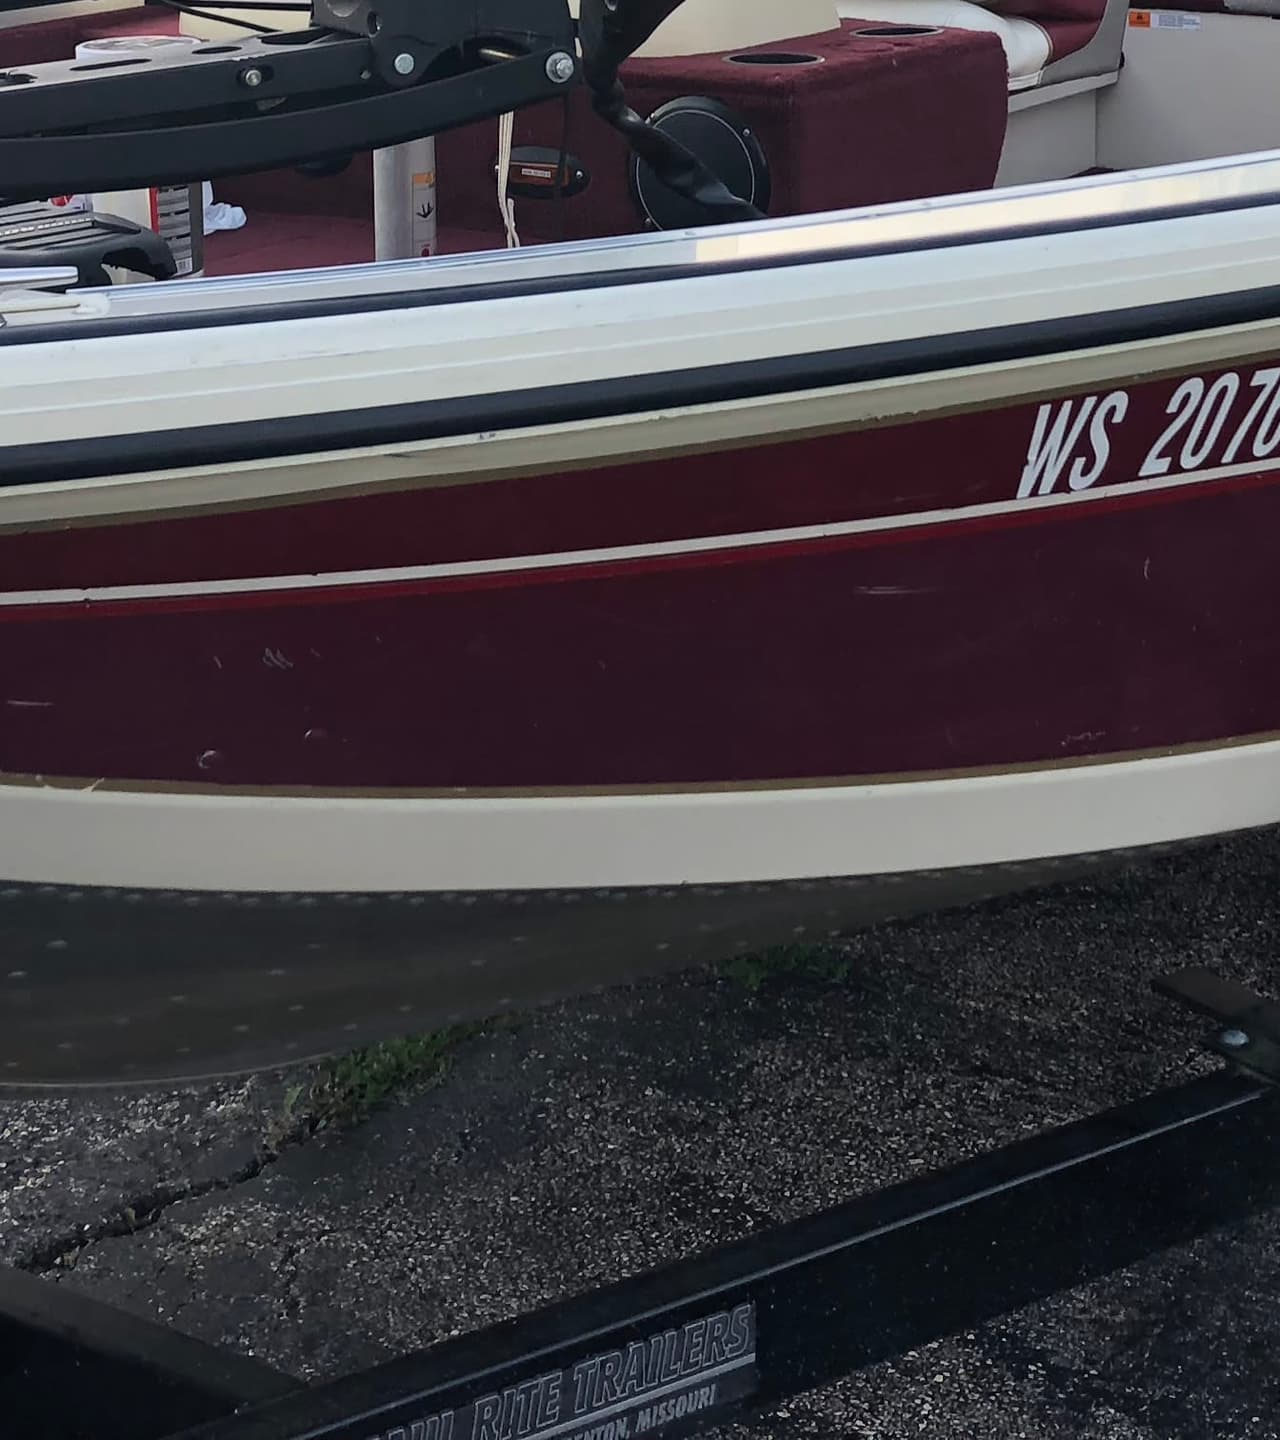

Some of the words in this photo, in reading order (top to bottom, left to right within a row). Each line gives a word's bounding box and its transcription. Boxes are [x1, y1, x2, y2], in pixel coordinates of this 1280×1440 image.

[1017, 391, 1128, 499] WS
[473, 1372, 563, 1440] RITE
[573, 1303, 751, 1413] TRAILERS
[635, 1384, 716, 1432] MISSOURI
